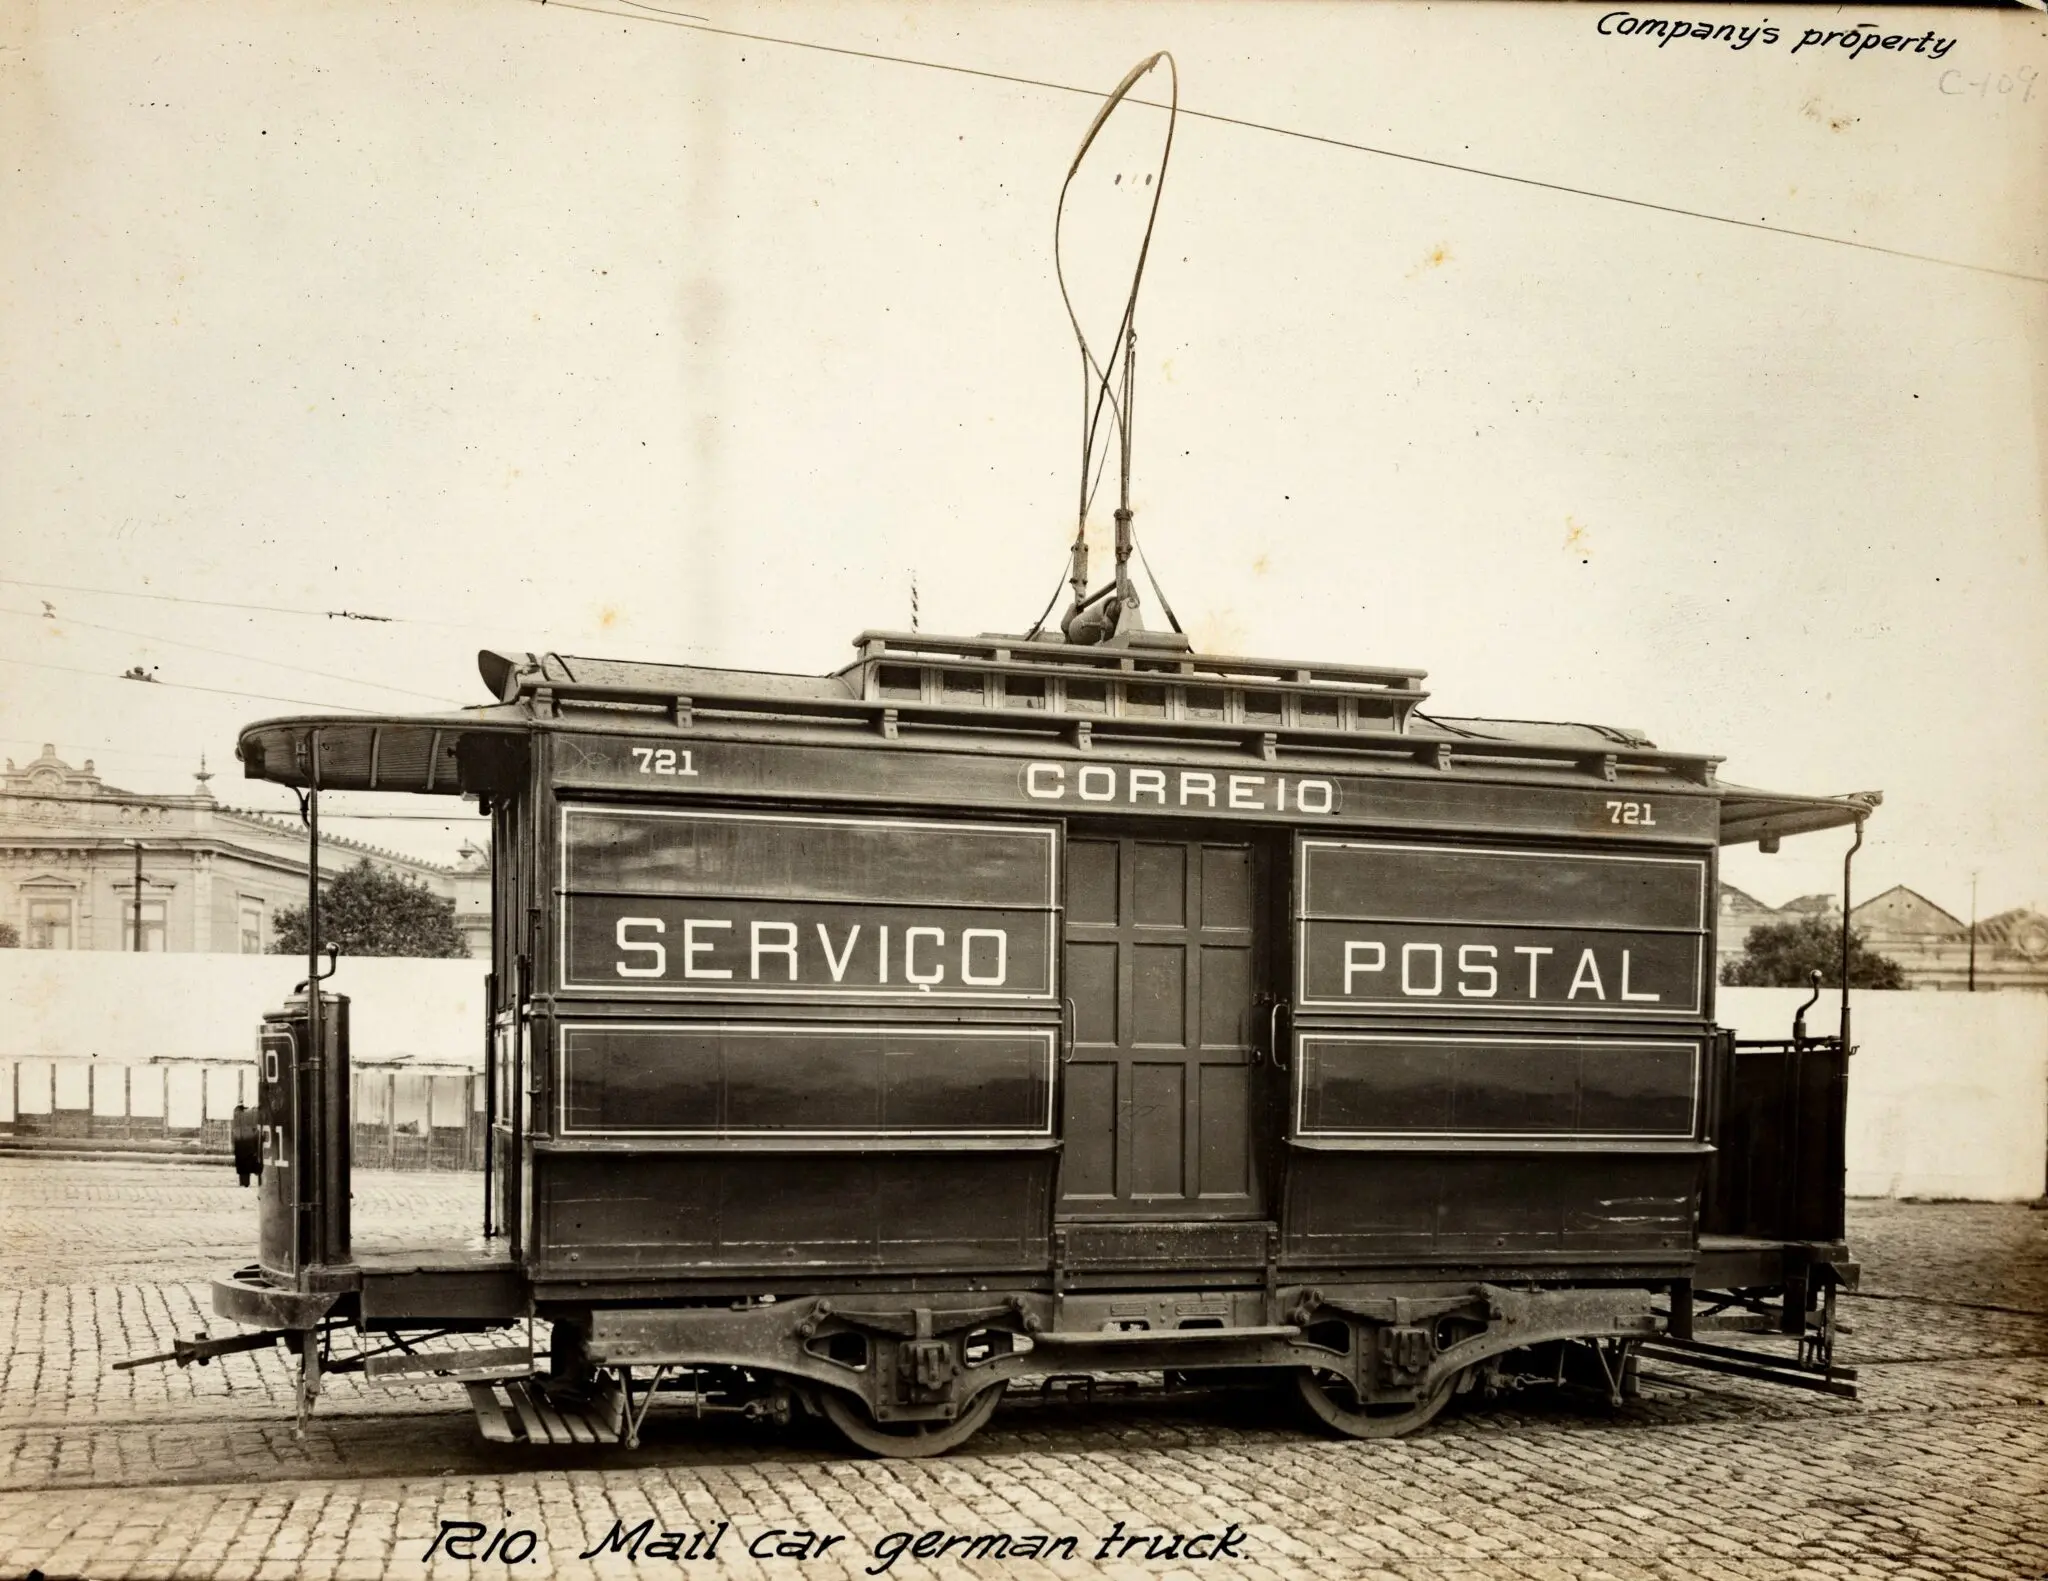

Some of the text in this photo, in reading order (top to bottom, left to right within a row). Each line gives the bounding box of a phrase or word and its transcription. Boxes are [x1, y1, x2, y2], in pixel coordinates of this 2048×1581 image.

[631, 747, 699, 777] 721
[1026, 760, 1333, 814] CORREIO
[1606, 800, 1657, 826] 721
[616, 916, 1660, 1002] SERVIÇO POSTAL
